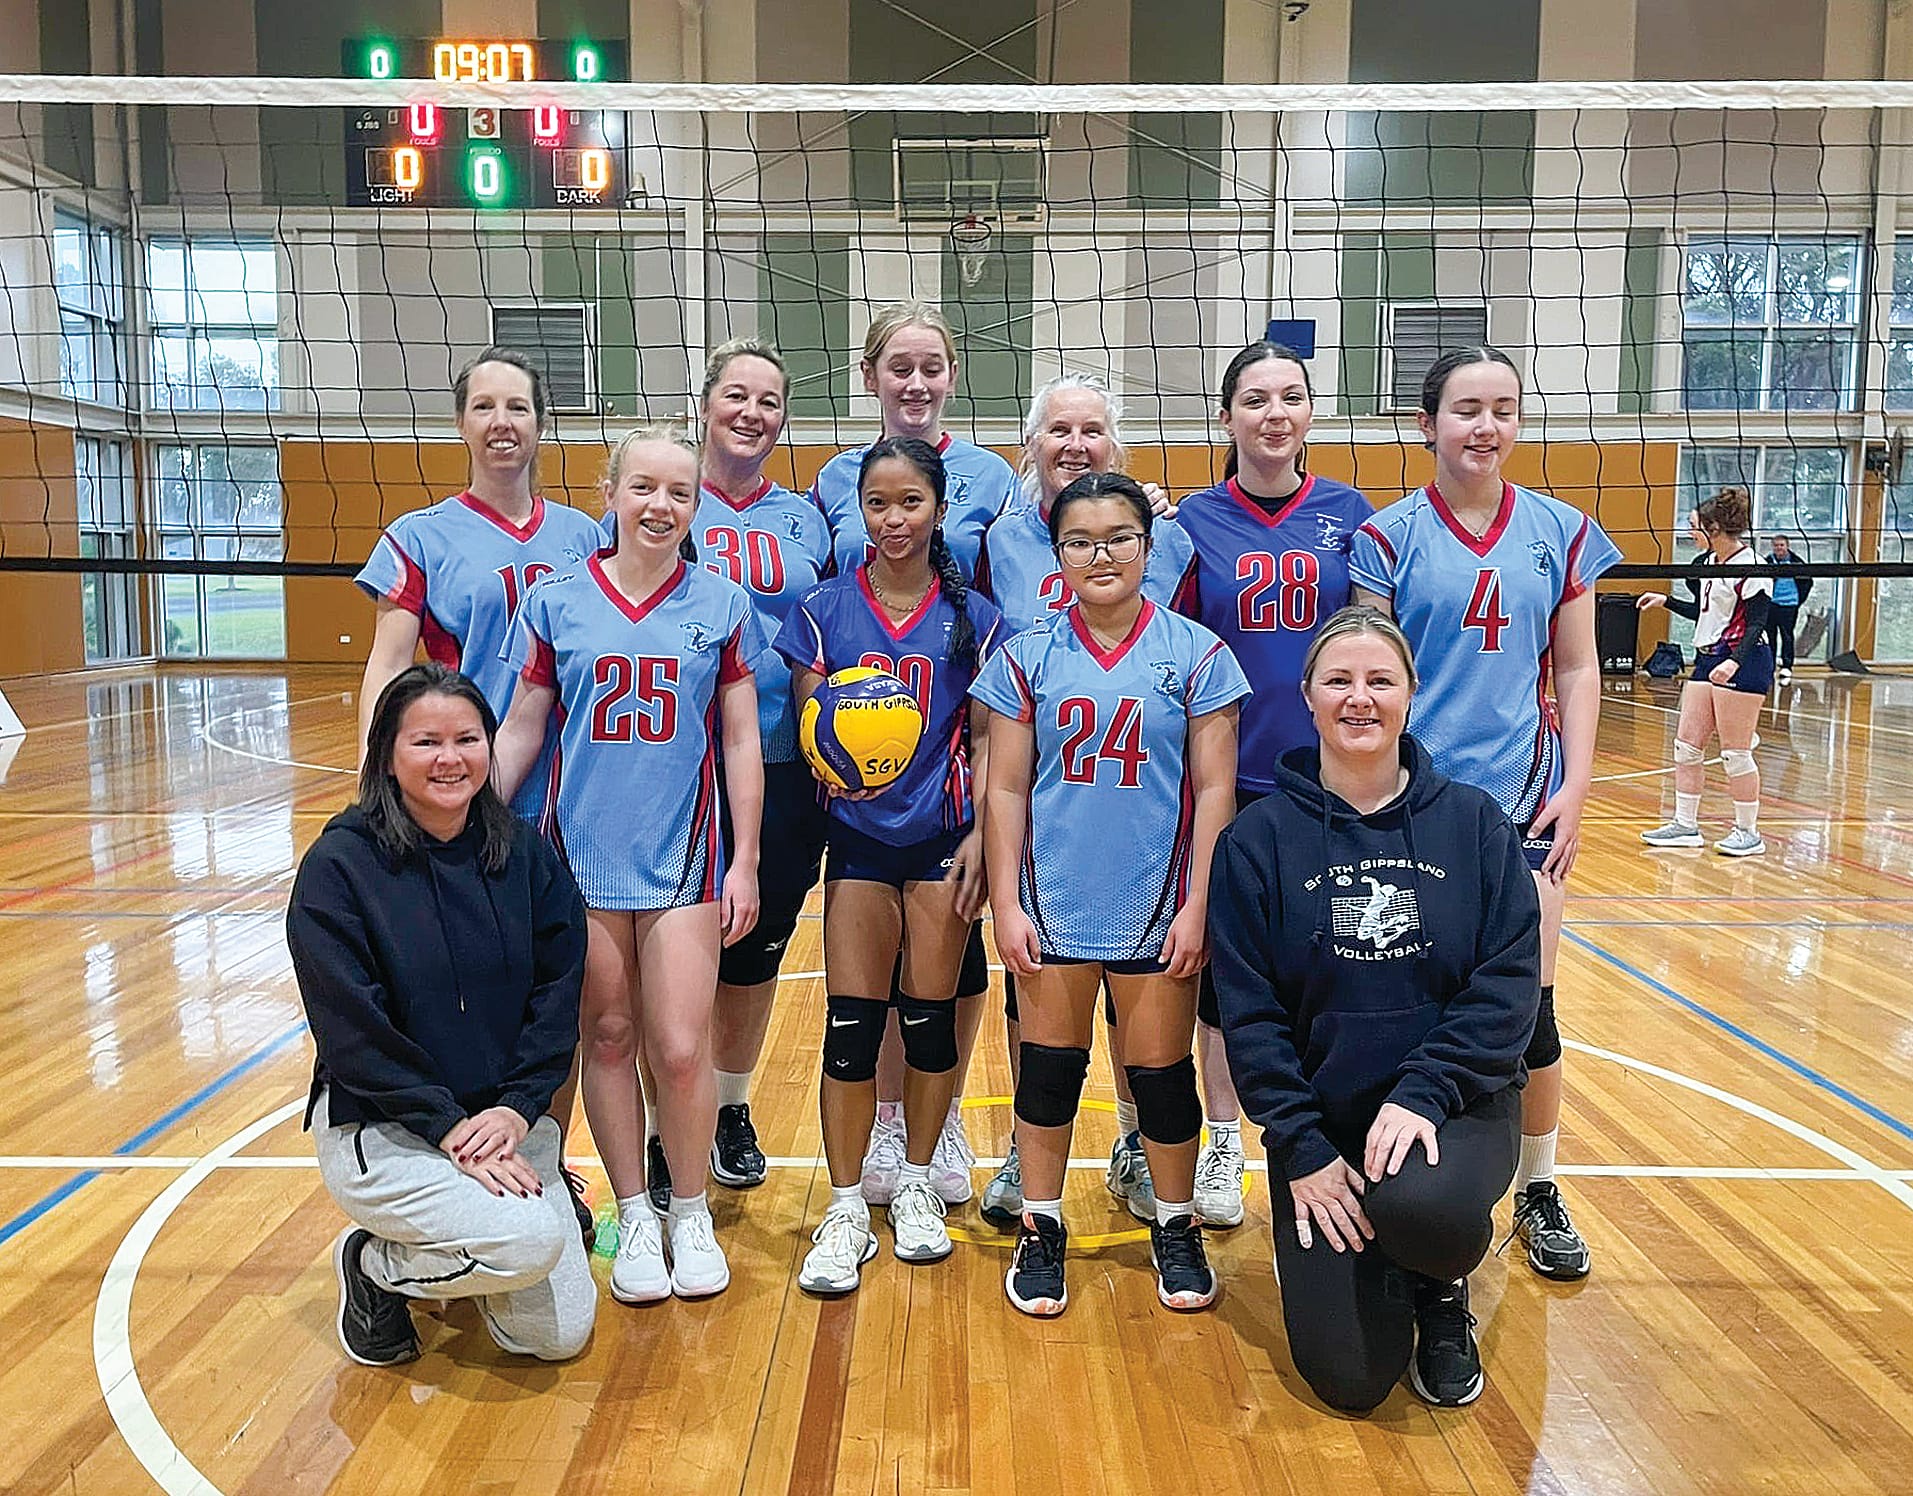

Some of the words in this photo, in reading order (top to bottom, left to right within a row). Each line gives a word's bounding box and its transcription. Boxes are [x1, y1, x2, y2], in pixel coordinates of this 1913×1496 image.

[370, 49, 389, 78] 0
[434, 44, 533, 82] 09:07
[576, 50, 595, 79] 0
[473, 108, 495, 136] 3
[393, 148, 420, 189] 0
[474, 156, 498, 197] 0
[581, 149, 608, 190] 0
[370, 188, 414, 203] LIGHT
[556, 189, 601, 204] DARK
[703, 524, 787, 595] 30
[1235, 550, 1320, 632] 28
[1461, 567, 1512, 654] 4
[590, 653, 680, 744] 25
[838, 700, 880, 711] SOUTH
[1056, 695, 1150, 789] 24
[864, 757, 907, 775] SGV
[1360, 858, 1447, 880] GIPPSLAND
